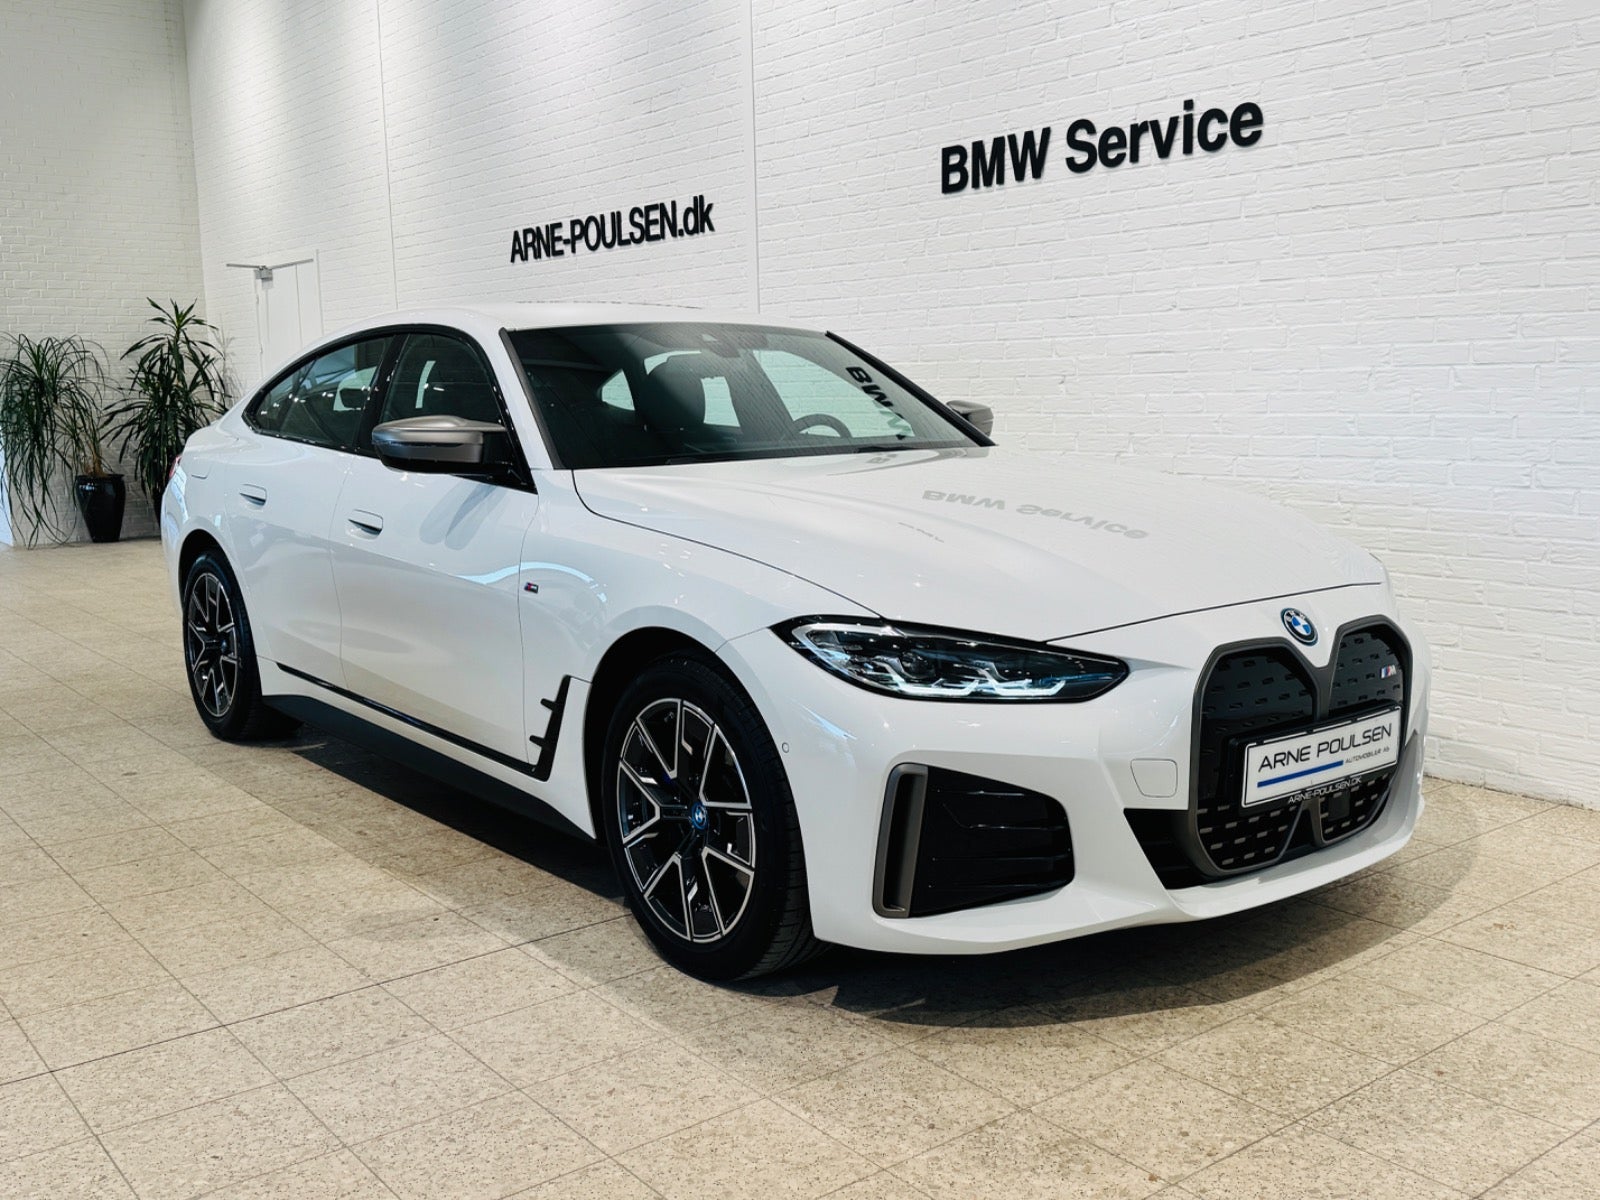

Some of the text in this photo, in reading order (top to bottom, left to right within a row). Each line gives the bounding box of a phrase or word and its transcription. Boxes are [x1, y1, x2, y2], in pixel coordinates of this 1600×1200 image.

[941, 99, 1264, 194] BMW Service
[510, 194, 716, 264] ARNE-POULSEN.dk
[1257, 722, 1393, 773] ARNE POULSEN
[1287, 776, 1363, 805] ARNE-POULSEN.DK
